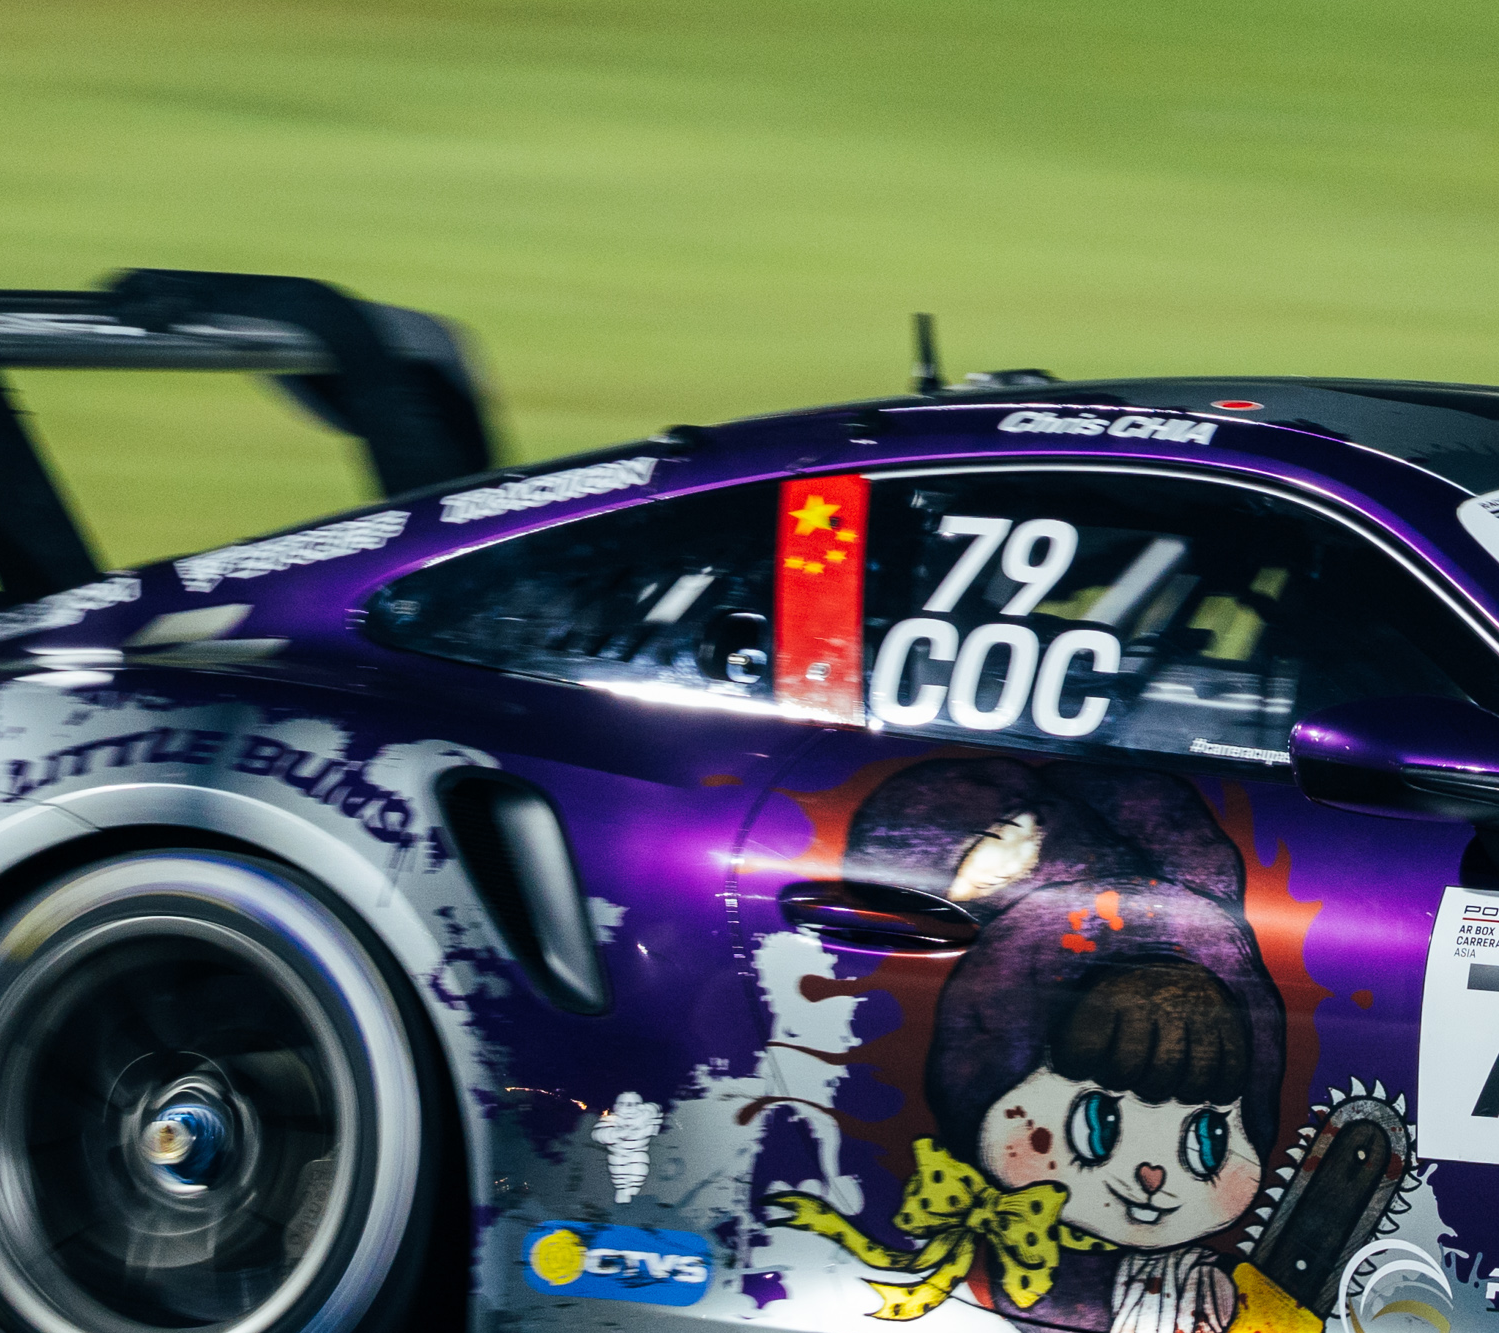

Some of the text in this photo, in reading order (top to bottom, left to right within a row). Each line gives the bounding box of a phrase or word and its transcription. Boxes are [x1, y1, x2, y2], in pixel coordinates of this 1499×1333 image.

[997, 411, 1218, 446] Chris CHIA
[922, 515, 1079, 616] 79
[869, 618, 1122, 737] COC
[2, 727, 235, 803] LITTLE
[1453, 948, 1477, 959] ASIA
[1458, 925, 1496, 937] AR BOX
